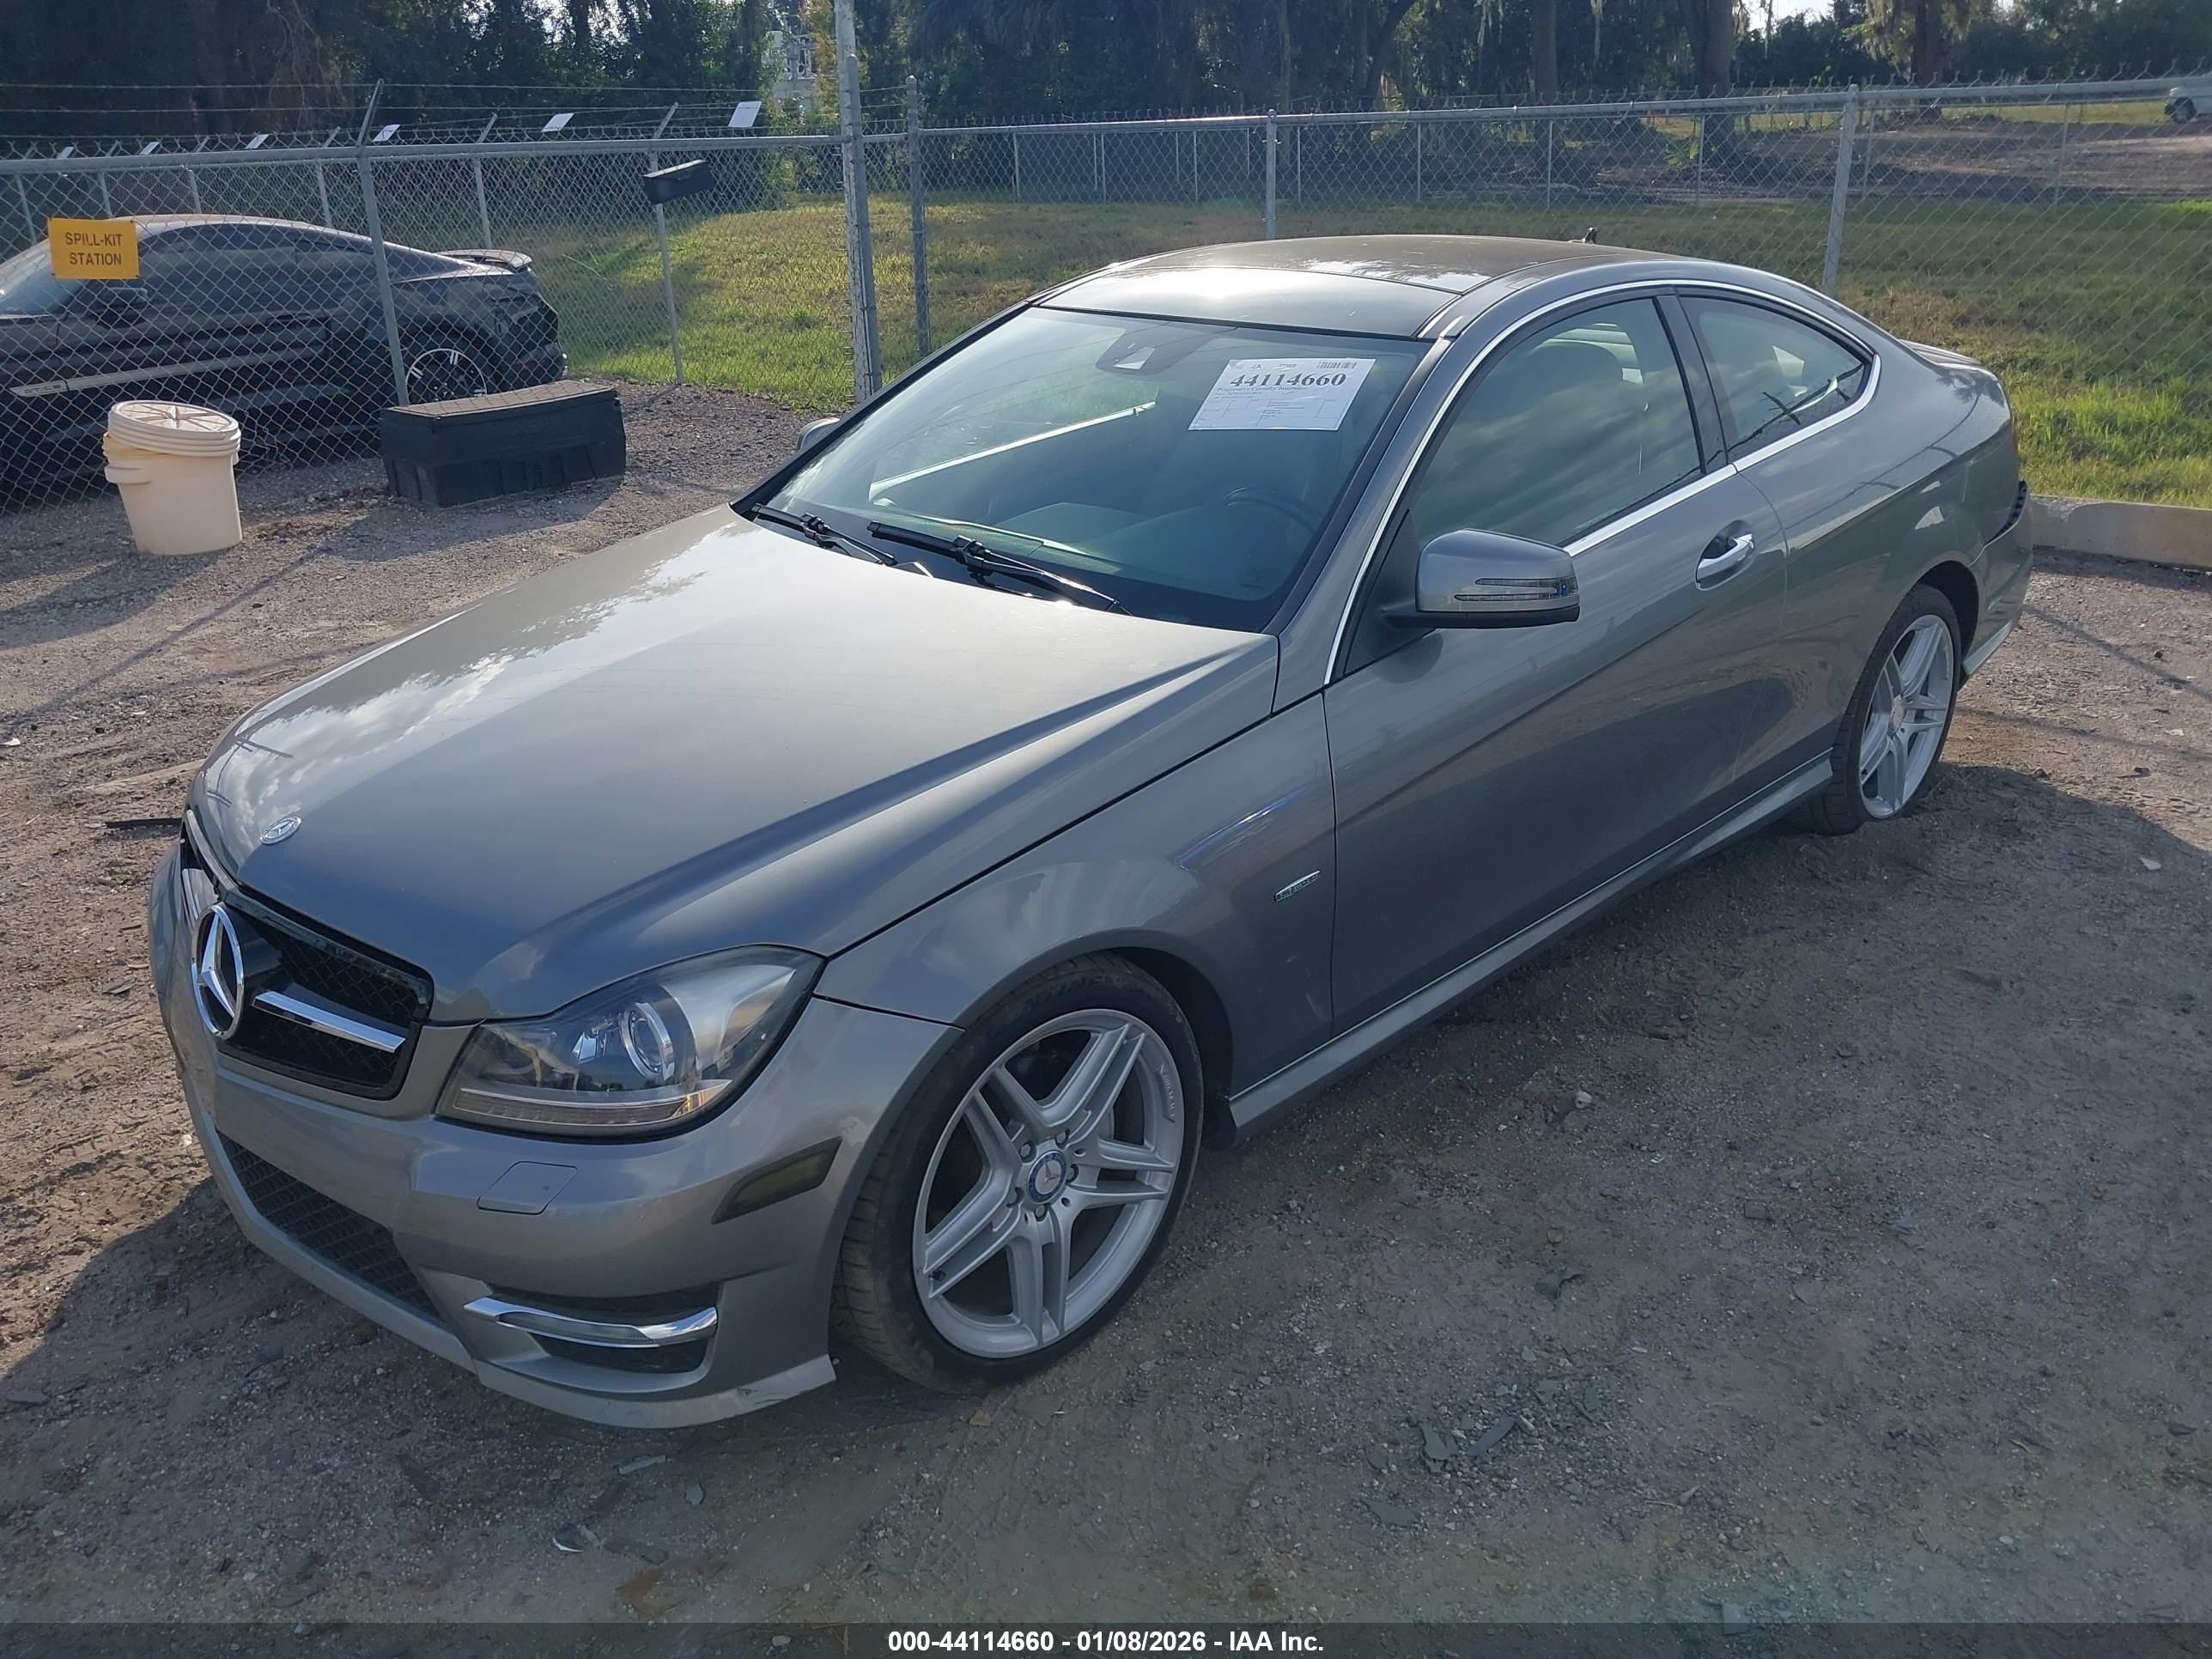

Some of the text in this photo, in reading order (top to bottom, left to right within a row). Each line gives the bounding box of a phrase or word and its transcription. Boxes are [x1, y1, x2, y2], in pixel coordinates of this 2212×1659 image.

[64, 232, 123, 246] SPILL-KIT
[69, 252, 122, 266] STATION
[1230, 373, 1346, 386] 44114660
